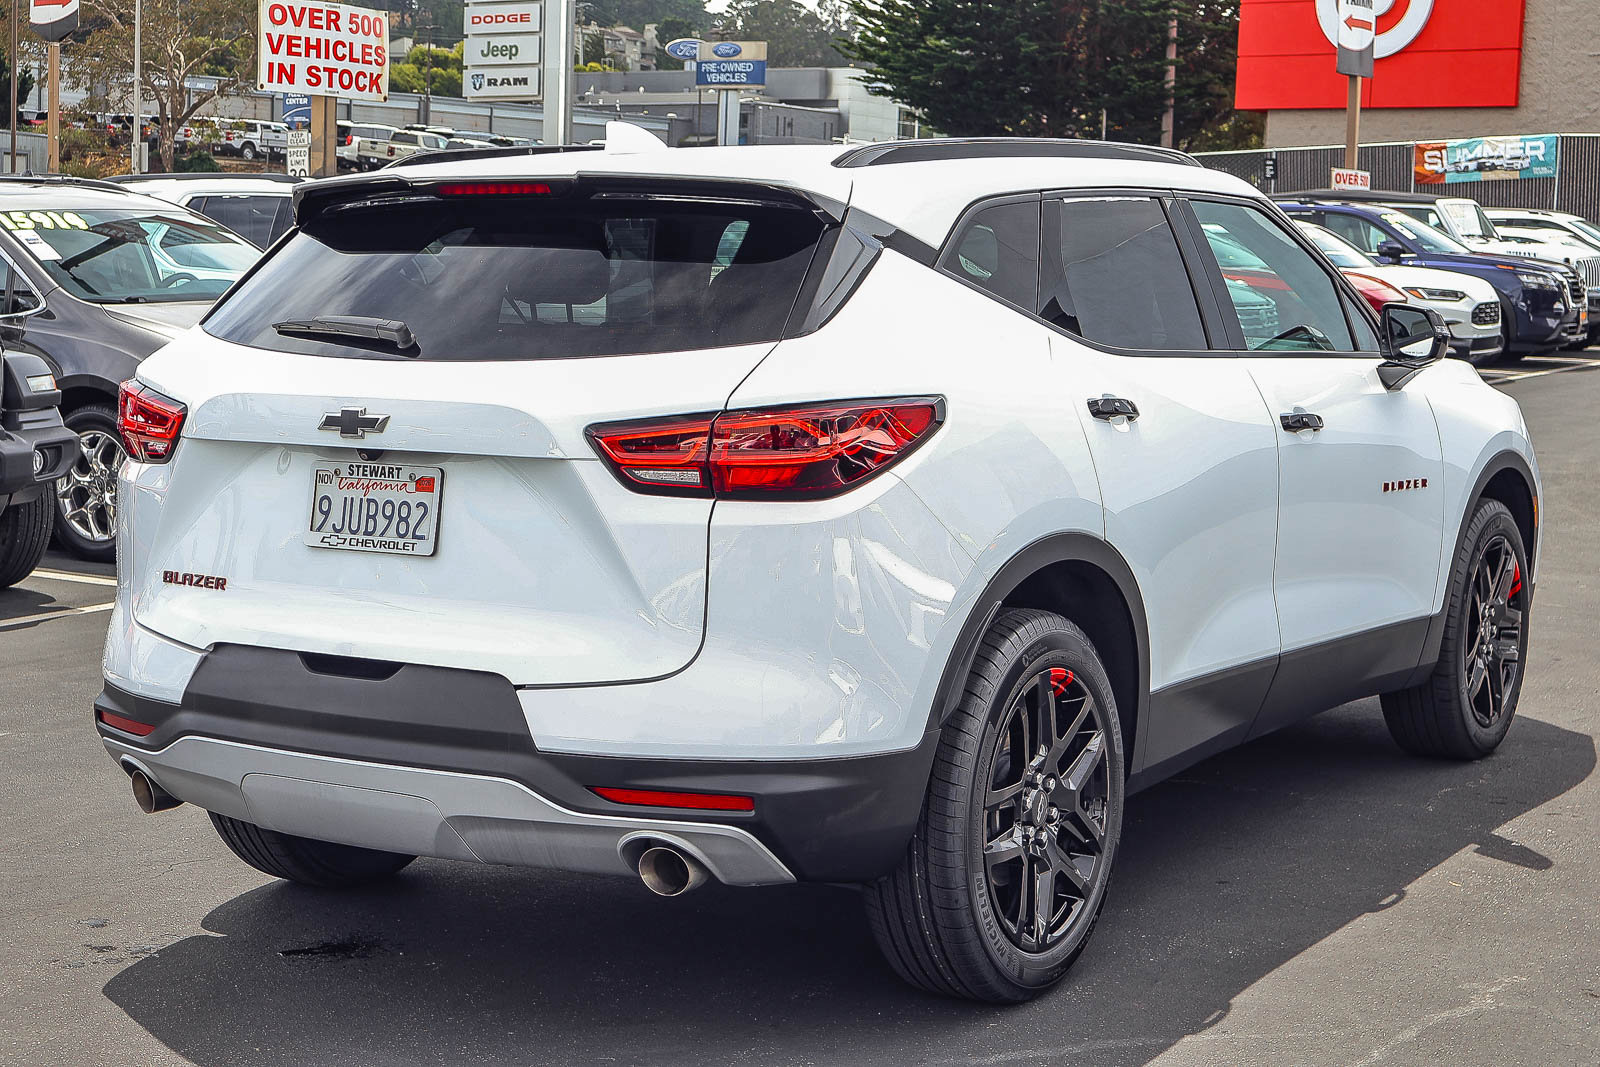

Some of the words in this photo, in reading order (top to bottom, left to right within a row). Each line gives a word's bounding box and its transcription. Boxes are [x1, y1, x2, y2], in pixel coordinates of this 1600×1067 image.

[268, 3, 341, 32] OVER
[348, 12, 384, 38] 500
[471, 13, 531, 25] DODGE
[265, 32, 386, 67] VEHICLES
[480, 41, 519, 60] Jeep
[701, 62, 754, 73] PRE-OWNED
[267, 62, 296, 85] IN
[305, 64, 383, 94] STOCK
[487, 77, 529, 87] RAM
[706, 72, 747, 83] VEHICLES
[289, 150, 307, 158] SPEED
[1424, 140, 1546, 171] SUMMER
[1335, 173, 1358, 185] OVER
[318, 473, 334, 485] NOV
[348, 464, 402, 479] STEWART
[338, 477, 416, 497] California
[1383, 478, 1428, 492] BLAZER
[316, 495, 429, 540] 9JUB982
[348, 537, 418, 551] CHEVROLET
[162, 570, 227, 591] BLAZER
[975, 877, 1008, 958] MICHELIN
